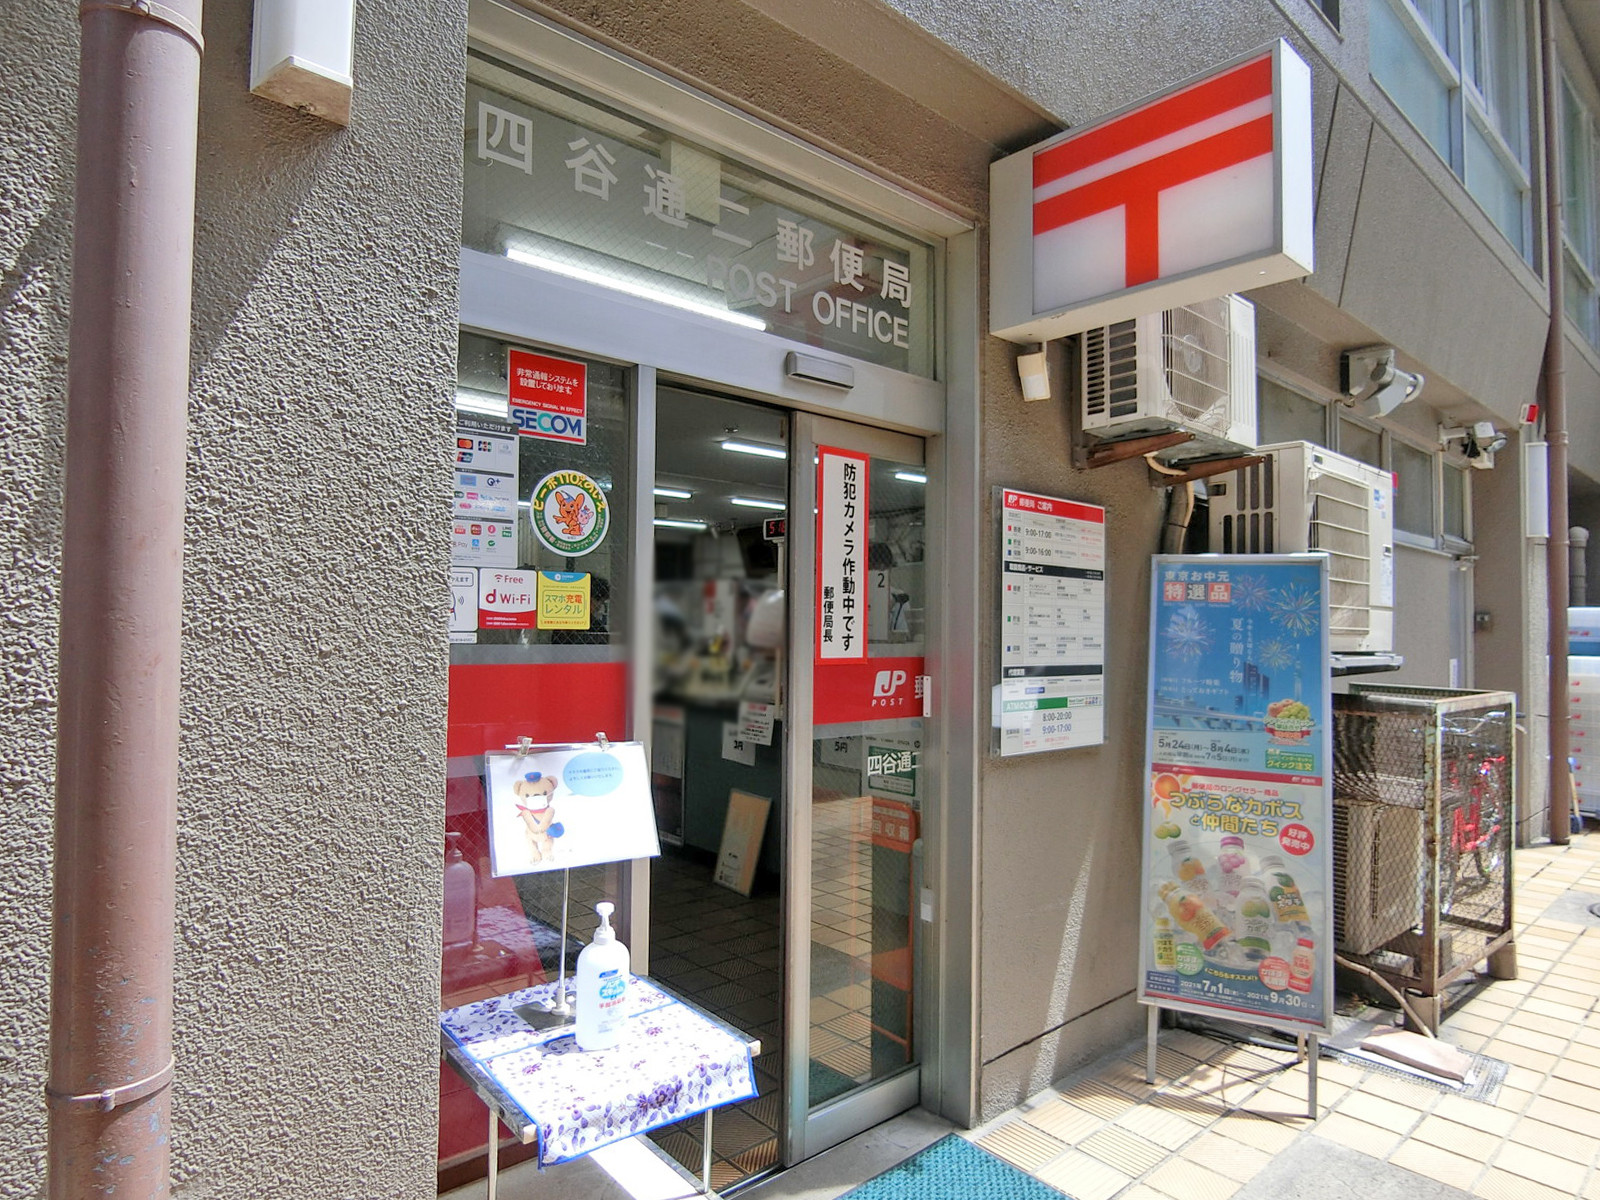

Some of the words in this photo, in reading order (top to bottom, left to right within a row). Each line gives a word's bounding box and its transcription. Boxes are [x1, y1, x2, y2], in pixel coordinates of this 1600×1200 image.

[477, 100, 912, 309] 四谷通二郵便局
[707, 254, 797, 314] POST
[812, 291, 909, 349] OFFICE
[516, 367, 579, 388] 非常通報システムを
[519, 377, 573, 396] 設置しております。
[512, 398, 541, 408] EMERGENCY
[542, 402, 560, 410] SIGNAL
[512, 408, 582, 437] SECOM
[1037, 501, 1053, 512] ご案内
[1025, 528, 1052, 538] 9:00-17:00
[842, 462, 857, 652] 防犯カメラ作動中です
[1025, 546, 1052, 556] 9:00-16:00
[504, 575, 524, 584] Free
[877, 572, 886, 588] 2
[1164, 570, 1230, 582] 東京お中元
[485, 588, 497, 604] d
[500, 594, 531, 604] Wi-Fi
[544, 594, 582, 604] スマホ充電
[1164, 583, 1229, 600] 特選品
[545, 604, 582, 614] レンタル
[822, 586, 834, 643] 郵便局長
[1230, 618, 1244, 683] 夏の贈り物
[873, 670, 906, 697] JP
[872, 698, 904, 707] POST
[1042, 711, 1072, 722] 8:00-20:00
[1042, 723, 1072, 735] 9:00-17:00
[834, 741, 848, 753] 5円
[1266, 760, 1312, 771] クイック注文
[1191, 782, 1279, 797] 郵便局のロングセラー商品
[1169, 790, 1304, 820] つぶらなカボス
[1190, 812, 1279, 837] と仲間たち
[1287, 828, 1308, 841] 好評
[1281, 836, 1310, 851] 発売中
